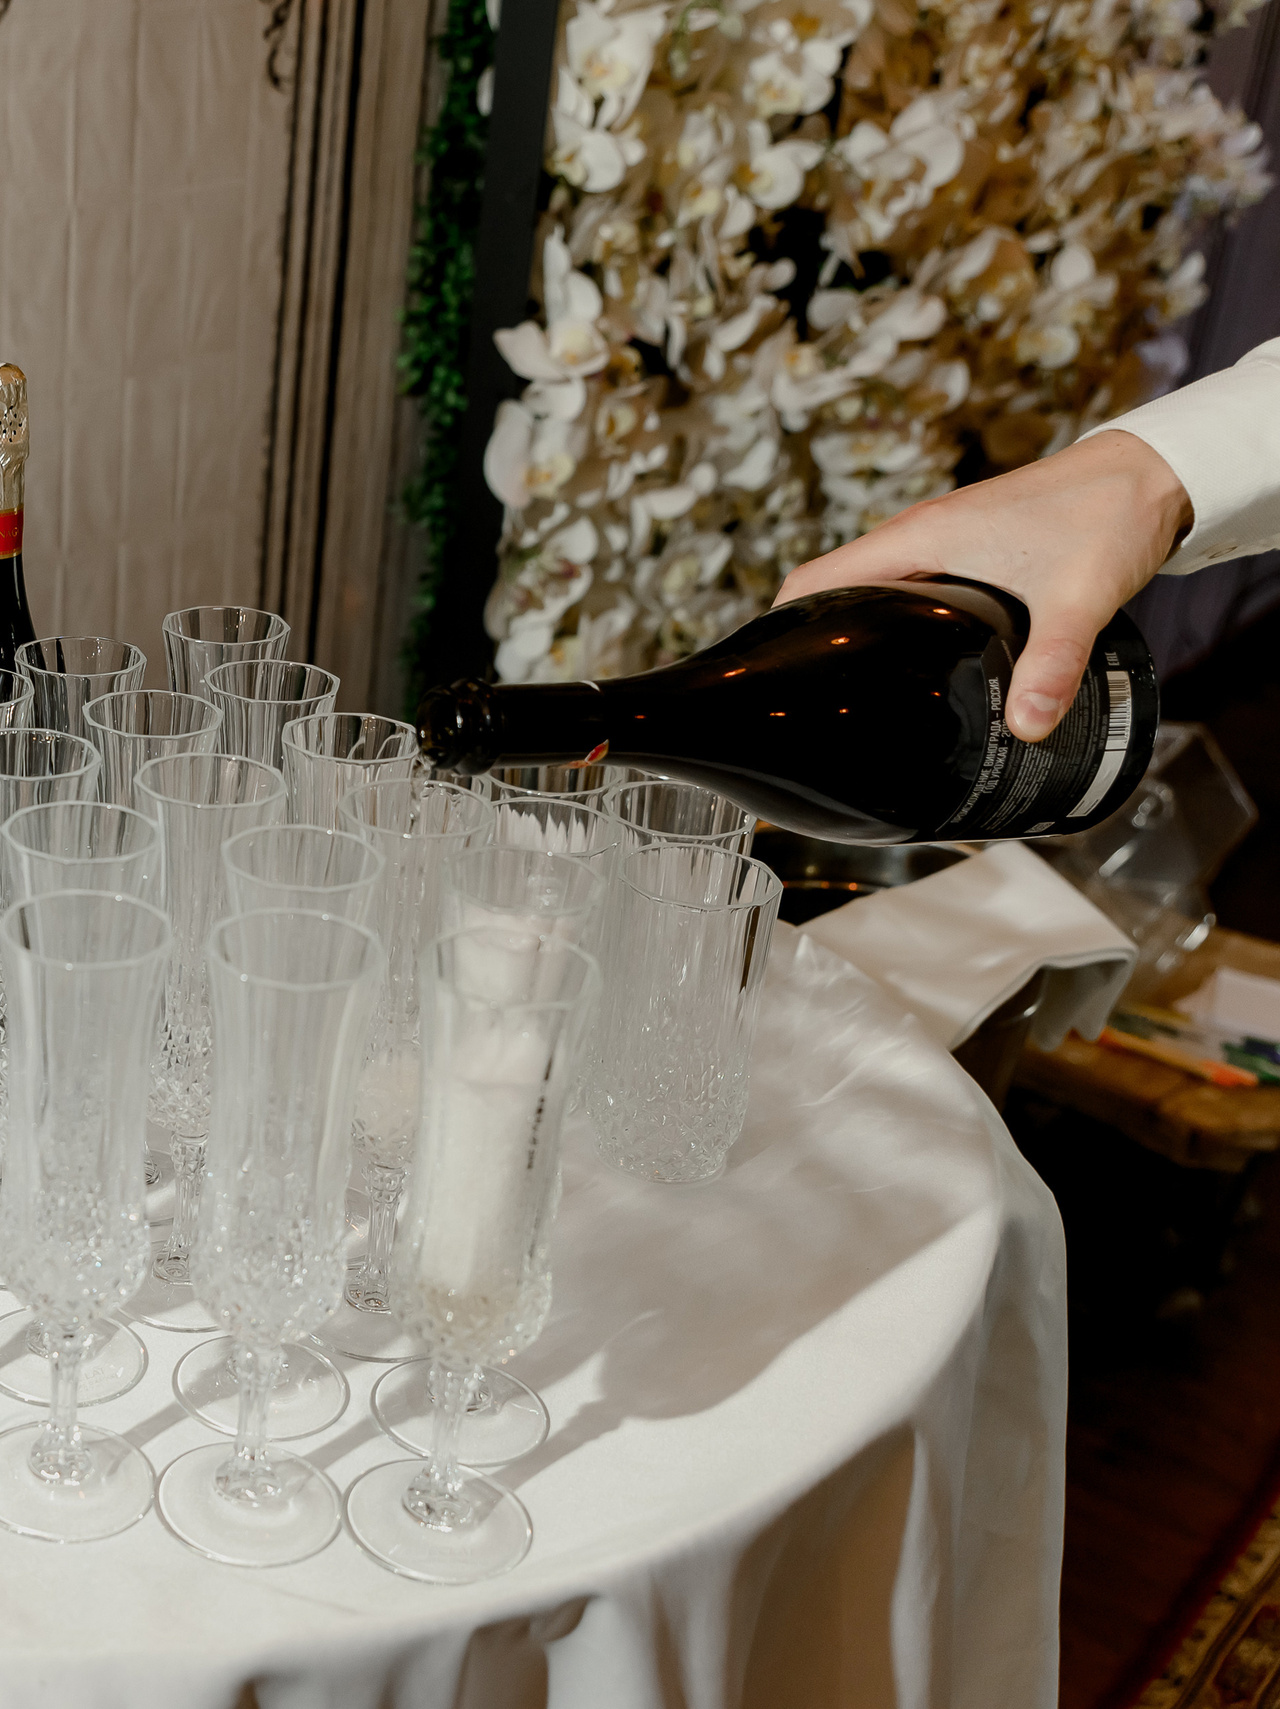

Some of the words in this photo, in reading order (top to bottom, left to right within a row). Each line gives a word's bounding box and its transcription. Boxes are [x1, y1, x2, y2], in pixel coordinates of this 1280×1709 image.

[983, 719, 1001, 767] ВИНОГРАДА
[990, 746, 1009, 779] УРОЖАЯ
[982, 779, 999, 794] ГОД
